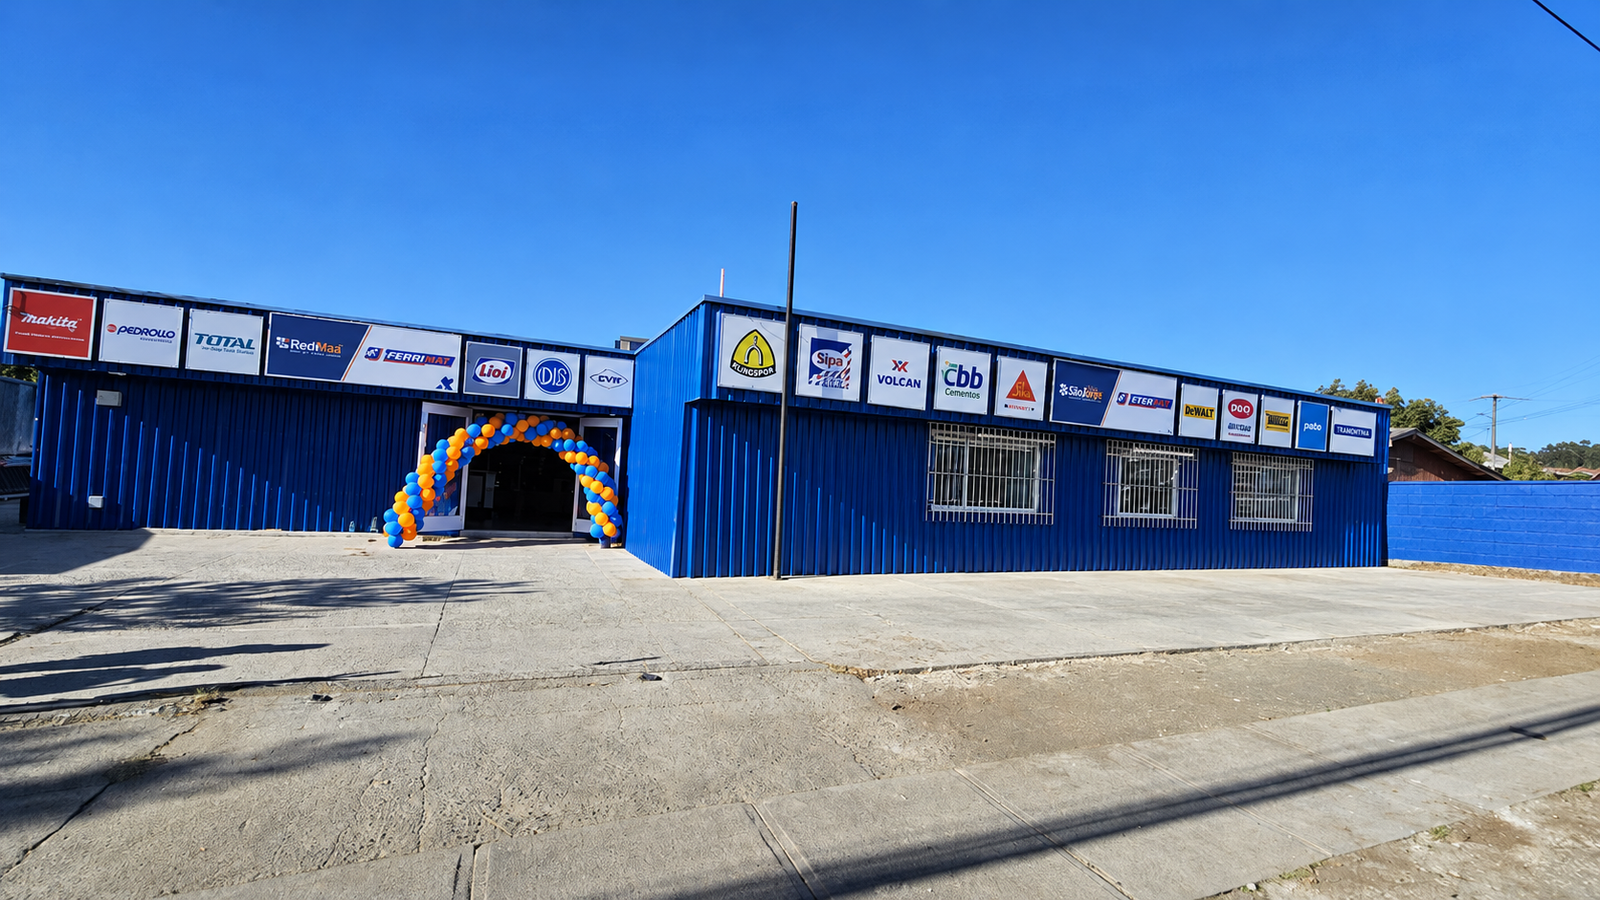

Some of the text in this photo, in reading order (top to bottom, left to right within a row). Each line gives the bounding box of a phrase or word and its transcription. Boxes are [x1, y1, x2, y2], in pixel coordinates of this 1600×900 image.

[20, 312, 78, 333] makita
[117, 326, 175, 339] PEDROLLO
[195, 333, 255, 350] TOTAL
[387, 351, 450, 365] FERRIMAT
[817, 352, 843, 369] Sipa
[479, 364, 508, 379] Lioi
[877, 374, 921, 388] VOLCAN
[945, 388, 980, 399] Cementos
[1185, 406, 1214, 418] DeWALT
[1303, 422, 1322, 431] pato
